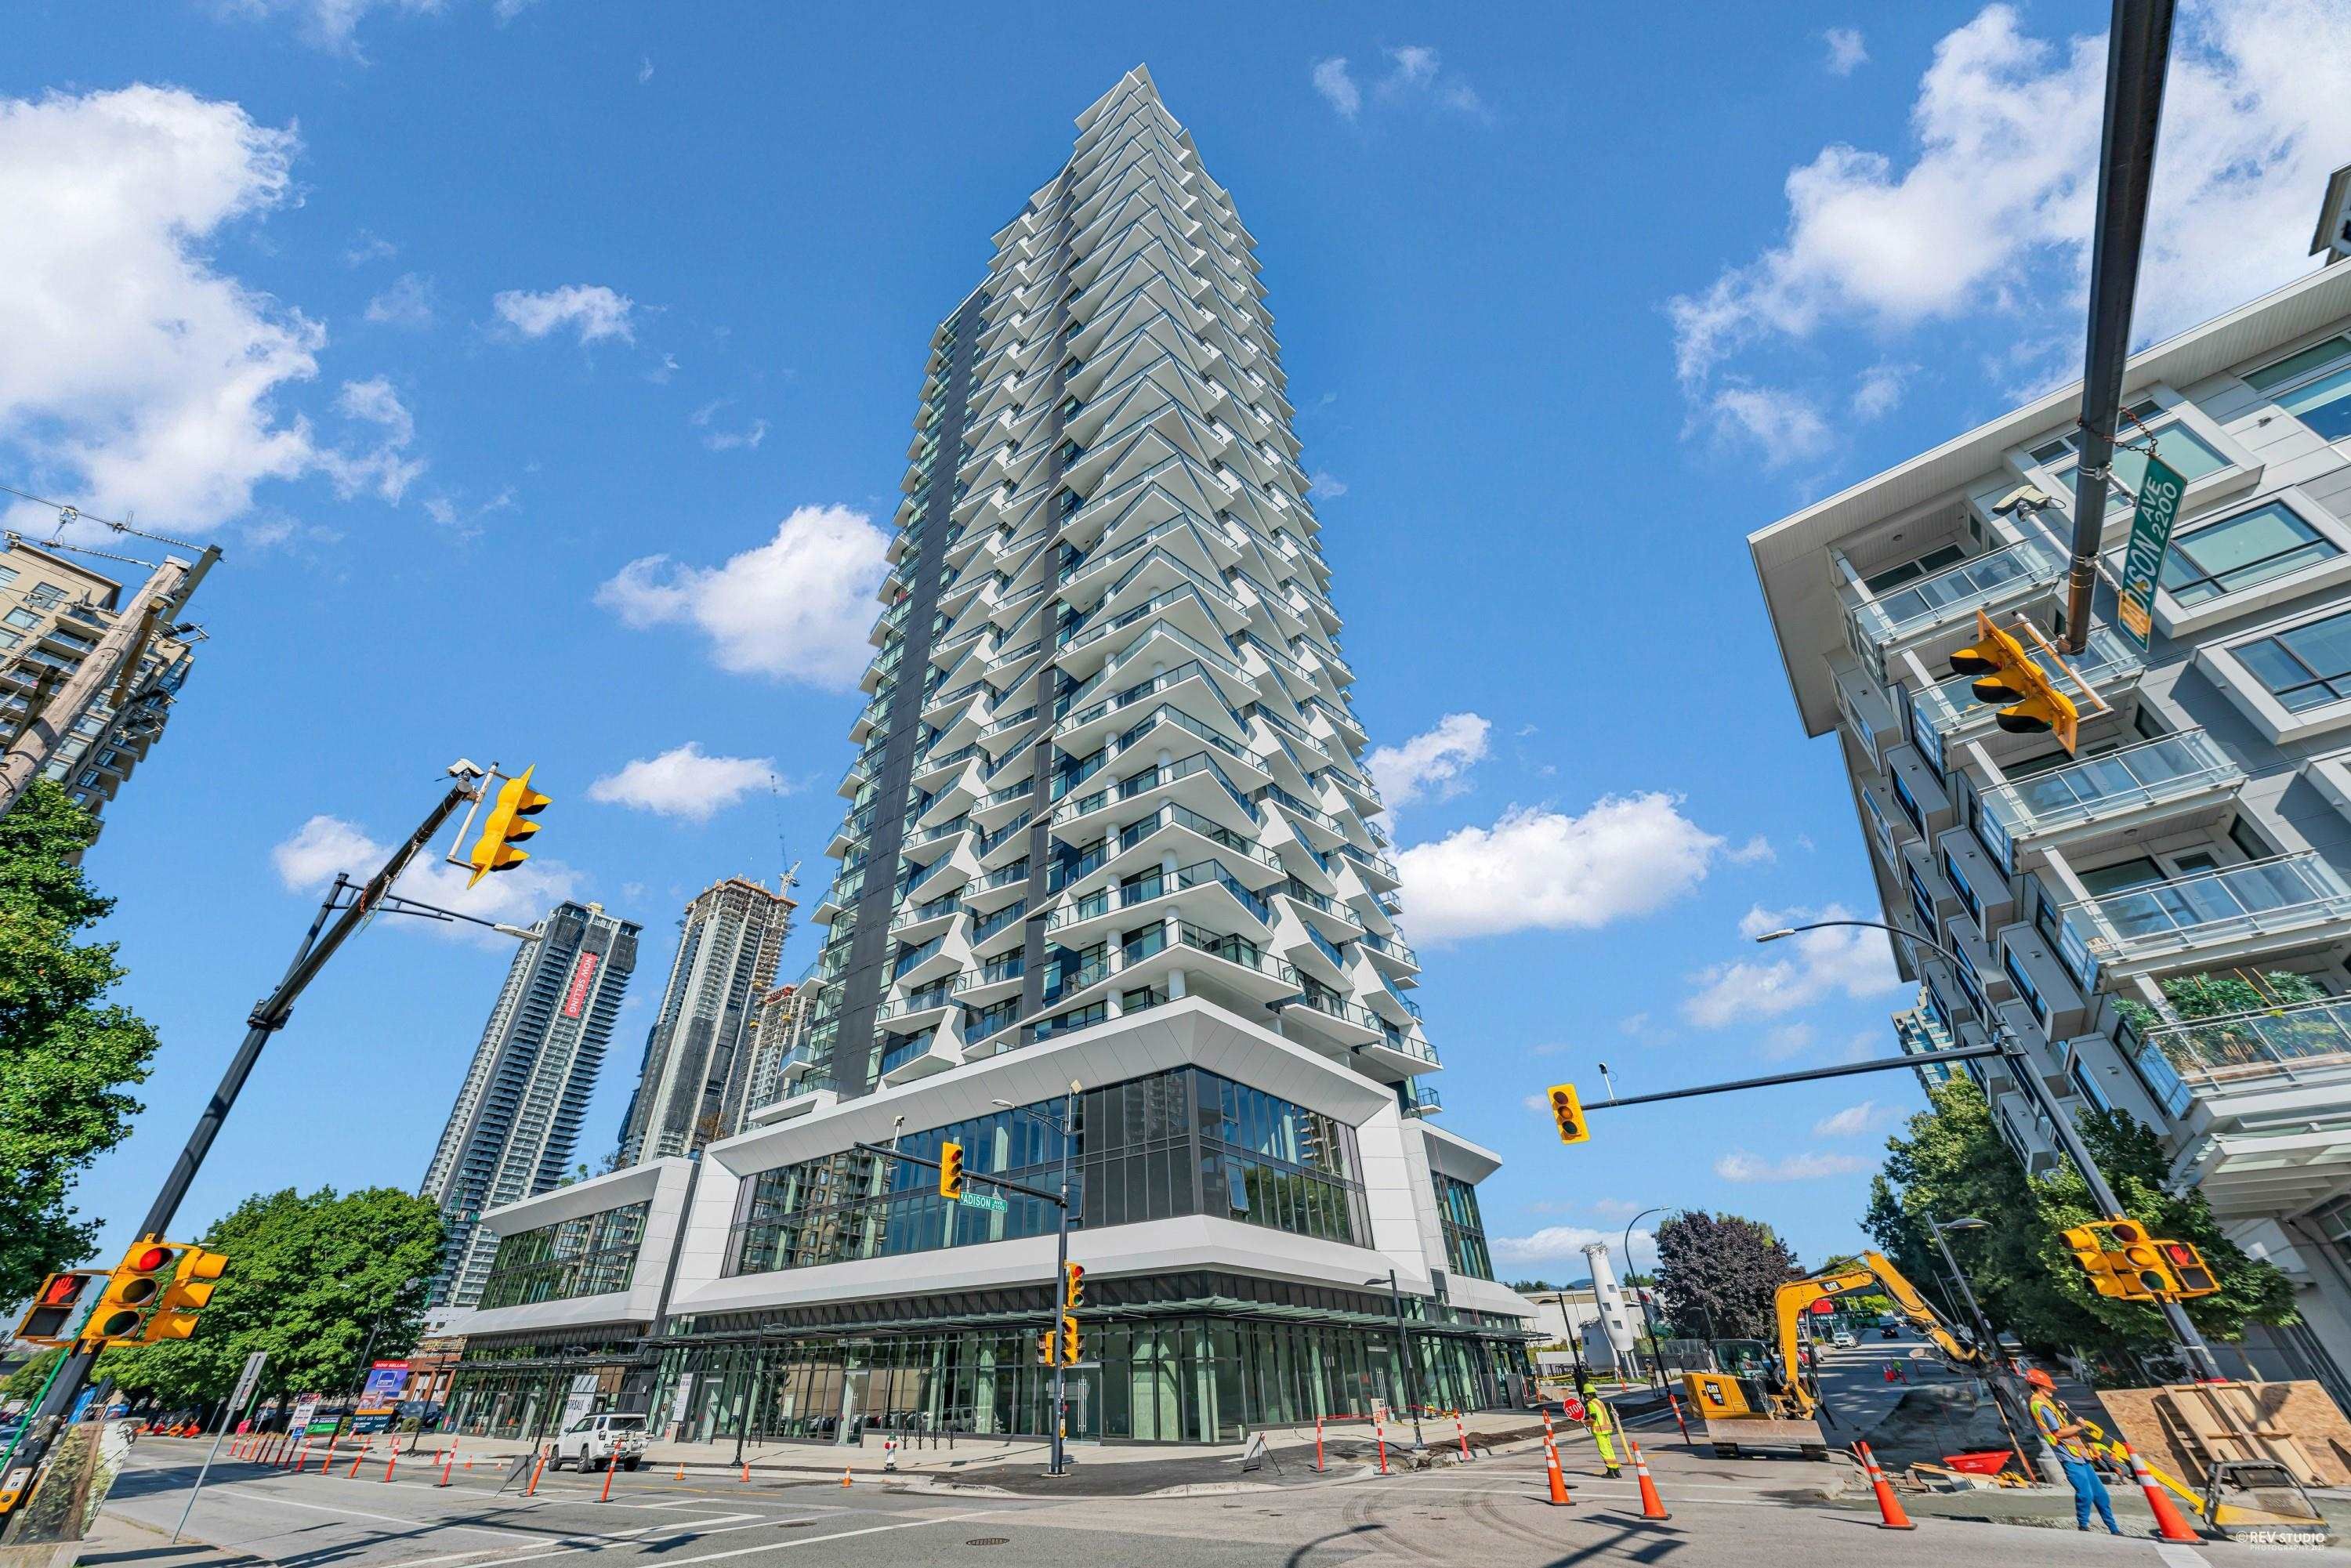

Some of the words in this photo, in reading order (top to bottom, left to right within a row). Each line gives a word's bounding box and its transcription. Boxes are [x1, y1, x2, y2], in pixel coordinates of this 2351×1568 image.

[2141, 476, 2161, 522] AVE
[2152, 482, 2177, 539] 2200
[581, 957, 593, 978] NOW
[569, 978, 585, 1013] SELLING
[1824, 1281, 1839, 1291] CAT
[1706, 1385, 1719, 1393] CAT
[1566, 1403, 1582, 1416] STOP
